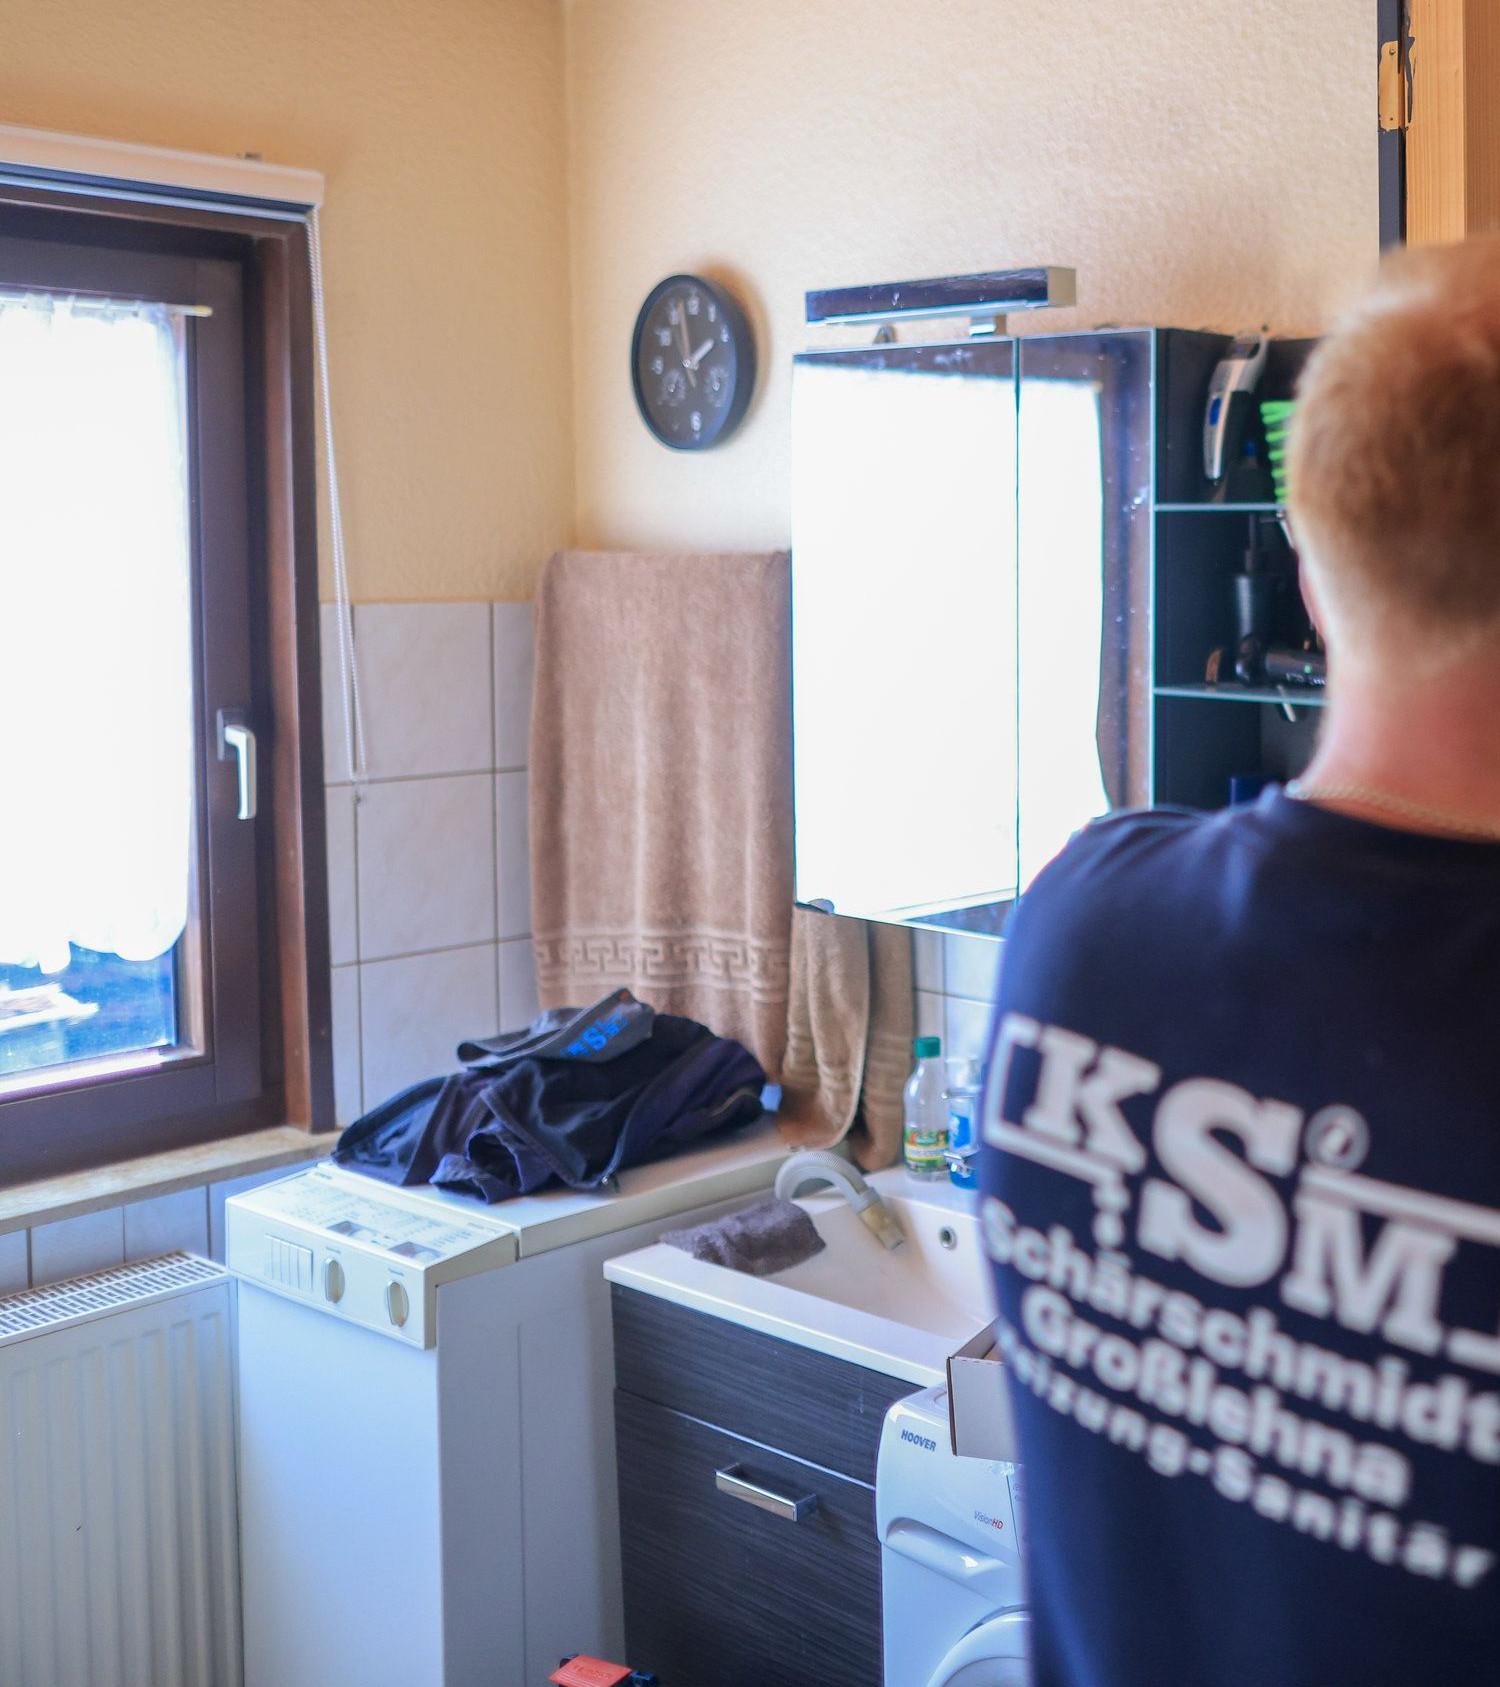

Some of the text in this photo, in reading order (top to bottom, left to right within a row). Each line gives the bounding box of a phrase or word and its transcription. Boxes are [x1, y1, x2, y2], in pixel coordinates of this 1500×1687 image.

[1022, 1020, 1459, 1358] KSM
[901, 1429, 936, 1451] HOOVER
[1021, 1282, 1412, 1509] Großlehna
